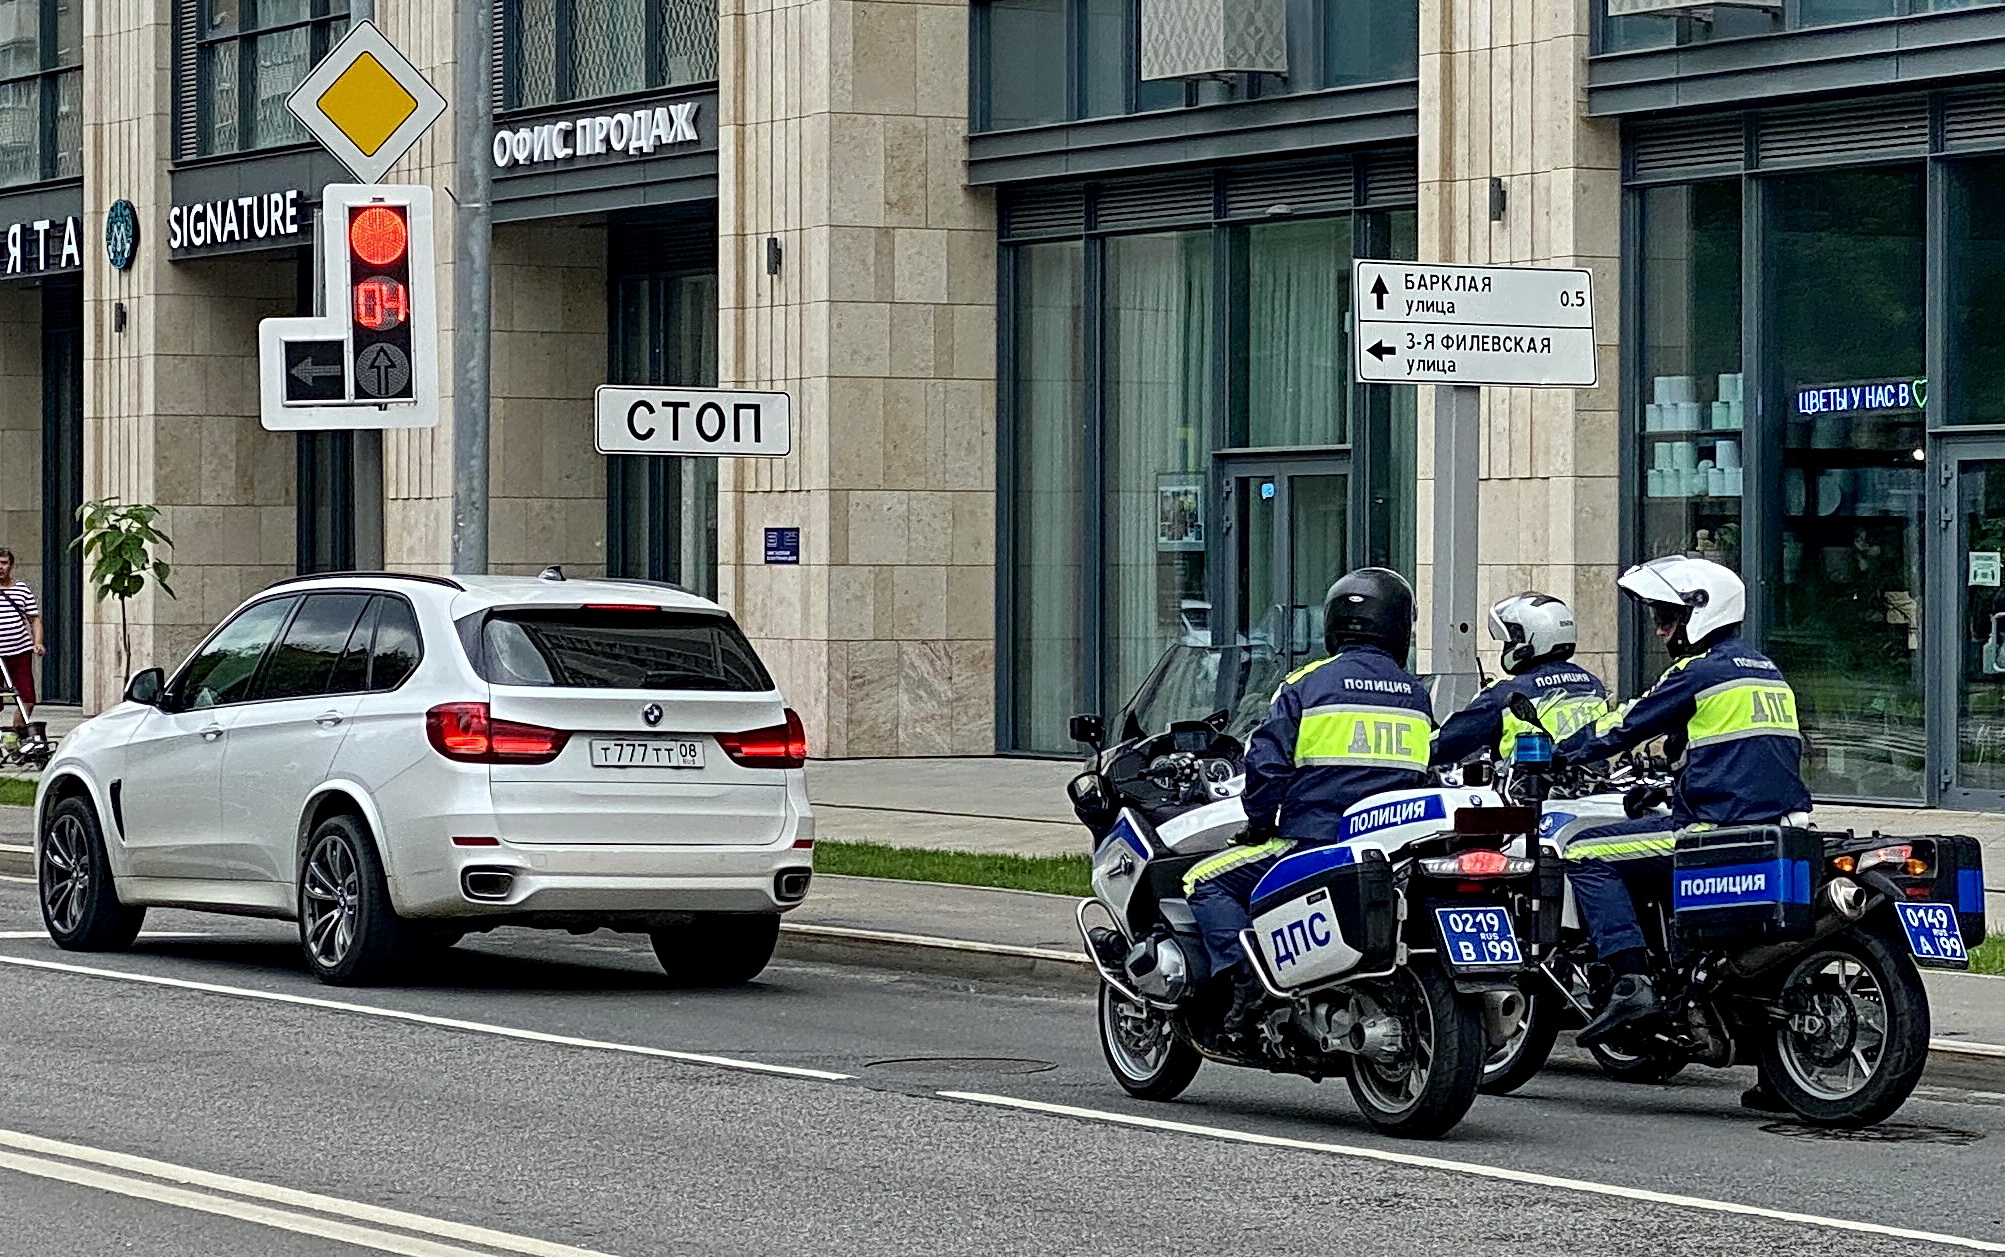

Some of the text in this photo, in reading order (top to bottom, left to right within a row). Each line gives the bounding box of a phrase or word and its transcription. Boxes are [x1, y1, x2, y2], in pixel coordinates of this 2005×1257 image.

[493, 102, 699, 168] ОФИС ПРОДАЖ
[169, 189, 298, 249] SIGNATURE
[1404, 273, 1492, 292] БАРКЛАЯ
[356, 282, 406, 327] 04
[1405, 299, 1456, 316] улица
[1560, 290, 1585, 307] 0.5
[1406, 332, 1551, 354] 3-Я ФИЛЕВСКАЯ
[1406, 358, 1457, 375] улица
[1799, 383, 1909, 415] ЦВЕТЫ У НАС В
[627, 400, 761, 443] СТОП
[1344, 678, 1412, 694] ПОЛИЦИЯ
[1535, 672, 1590, 687] ПОЛИЦИЯ
[1751, 691, 1793, 723] ДПС
[1348, 720, 1412, 756] ДПС
[680, 743, 697, 758] 08
[1349, 800, 1426, 835] ПОЛИЦИЯ
[1681, 873, 1765, 897] ПОЛИЦИЯ
[1449, 912, 1499, 932] 0219
[1906, 908, 1948, 928] 0149
[1271, 912, 1331, 971] ДПС
[1480, 932, 1499, 940] RUS
[1940, 937, 1961, 956] 99
[1488, 940, 1513, 961] 99
